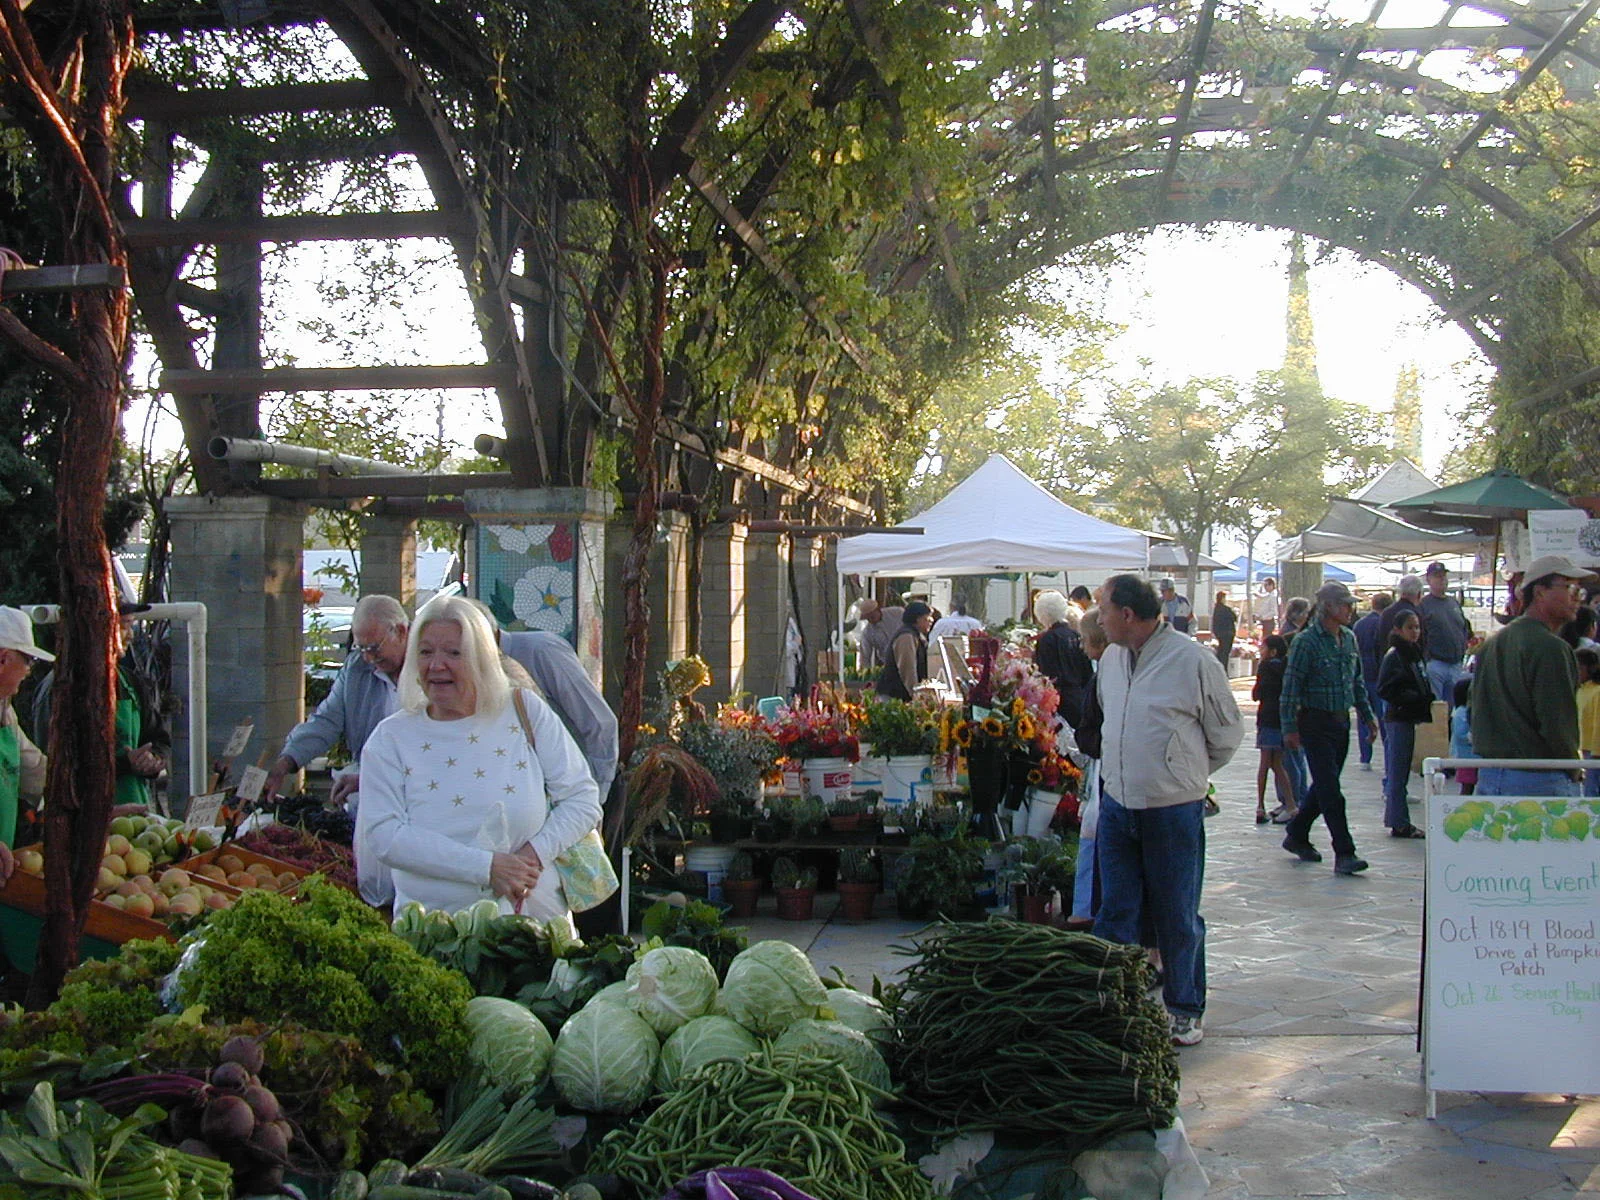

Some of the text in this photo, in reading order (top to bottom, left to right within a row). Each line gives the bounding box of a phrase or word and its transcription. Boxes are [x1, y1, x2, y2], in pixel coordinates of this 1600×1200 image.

[1444, 864, 1531, 904] Coming
[1439, 915, 1478, 943] Oct
[1545, 919, 1596, 940] Blood
[1474, 945, 1517, 960] Drive
[1524, 943, 1538, 959] at
[1500, 960, 1545, 977] Patch
[1442, 981, 1476, 1010] Oct
[1511, 982, 1561, 1000] Senior
[1546, 1001, 1584, 1024] Day
